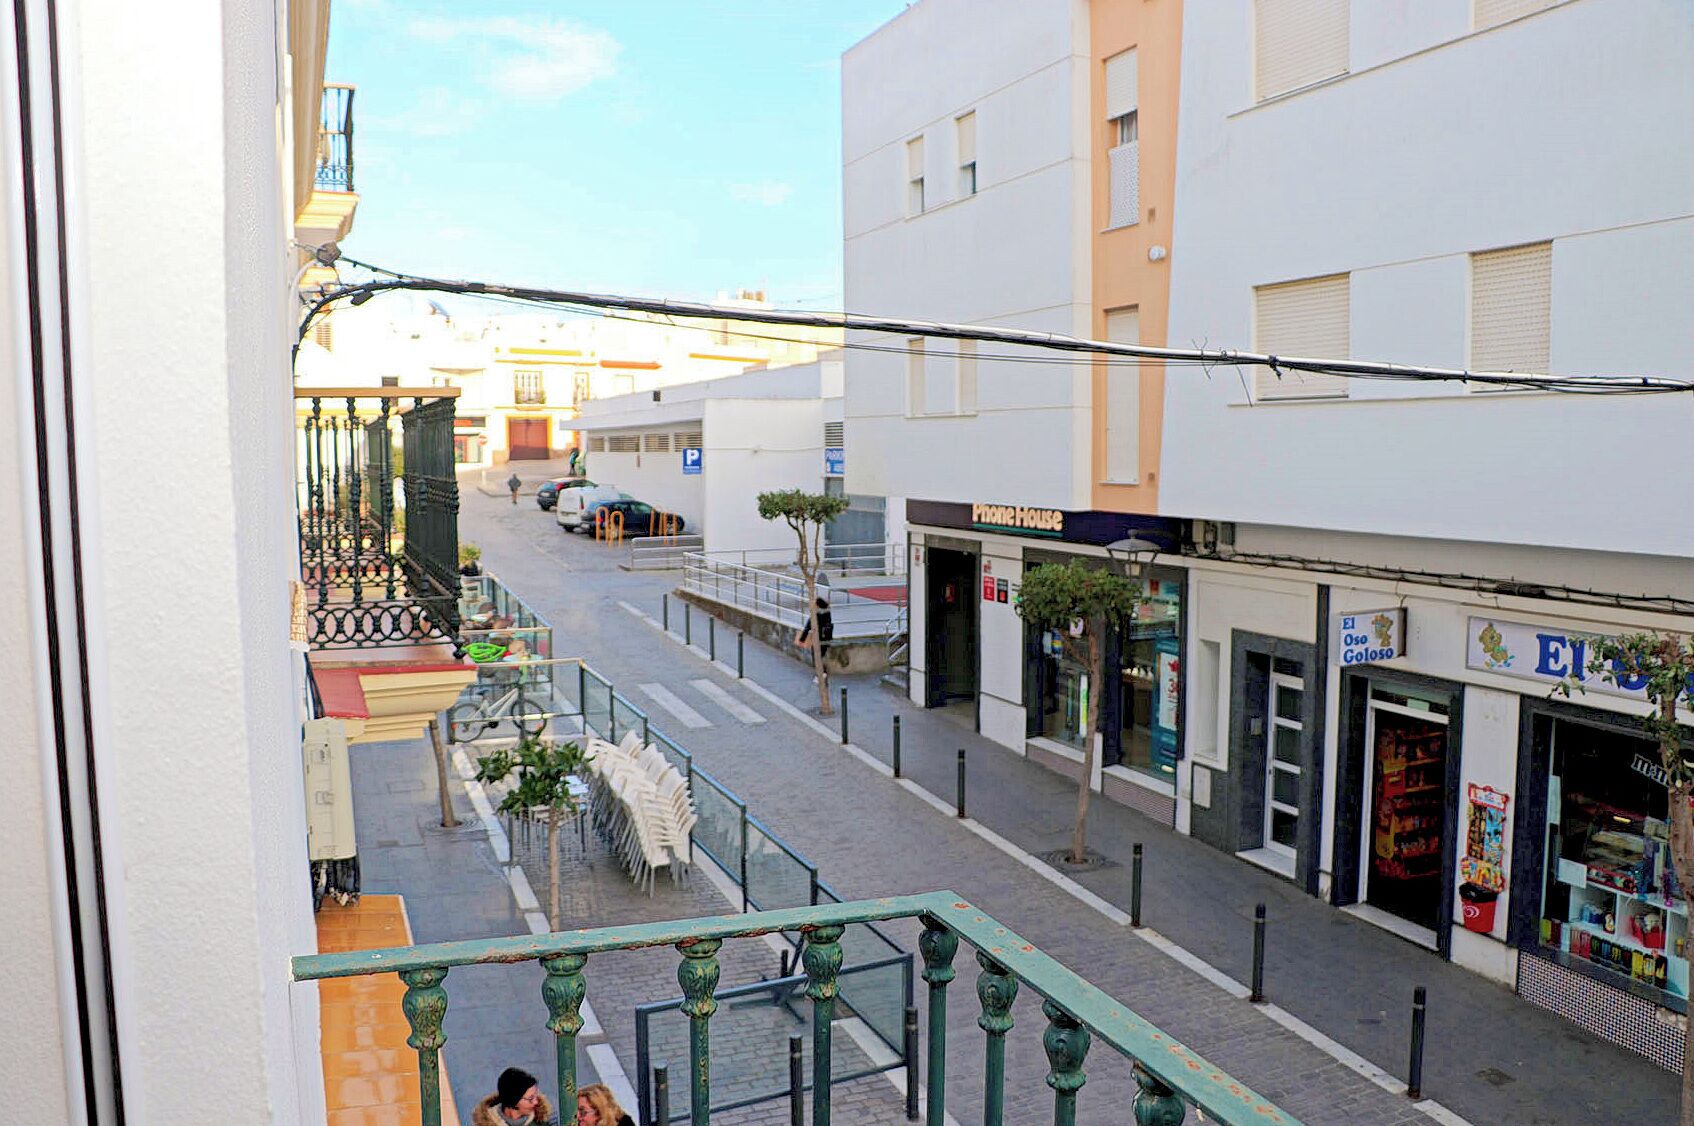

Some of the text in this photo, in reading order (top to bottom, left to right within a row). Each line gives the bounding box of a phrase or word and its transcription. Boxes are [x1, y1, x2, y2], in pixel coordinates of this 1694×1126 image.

[686, 449, 700, 465] P
[972, 504, 1063, 531] Phone House
[1343, 617, 1355, 630] El
[1344, 634, 1368, 646] Oso
[1344, 647, 1394, 663] Goloso
[1535, 633, 1585, 681] El
